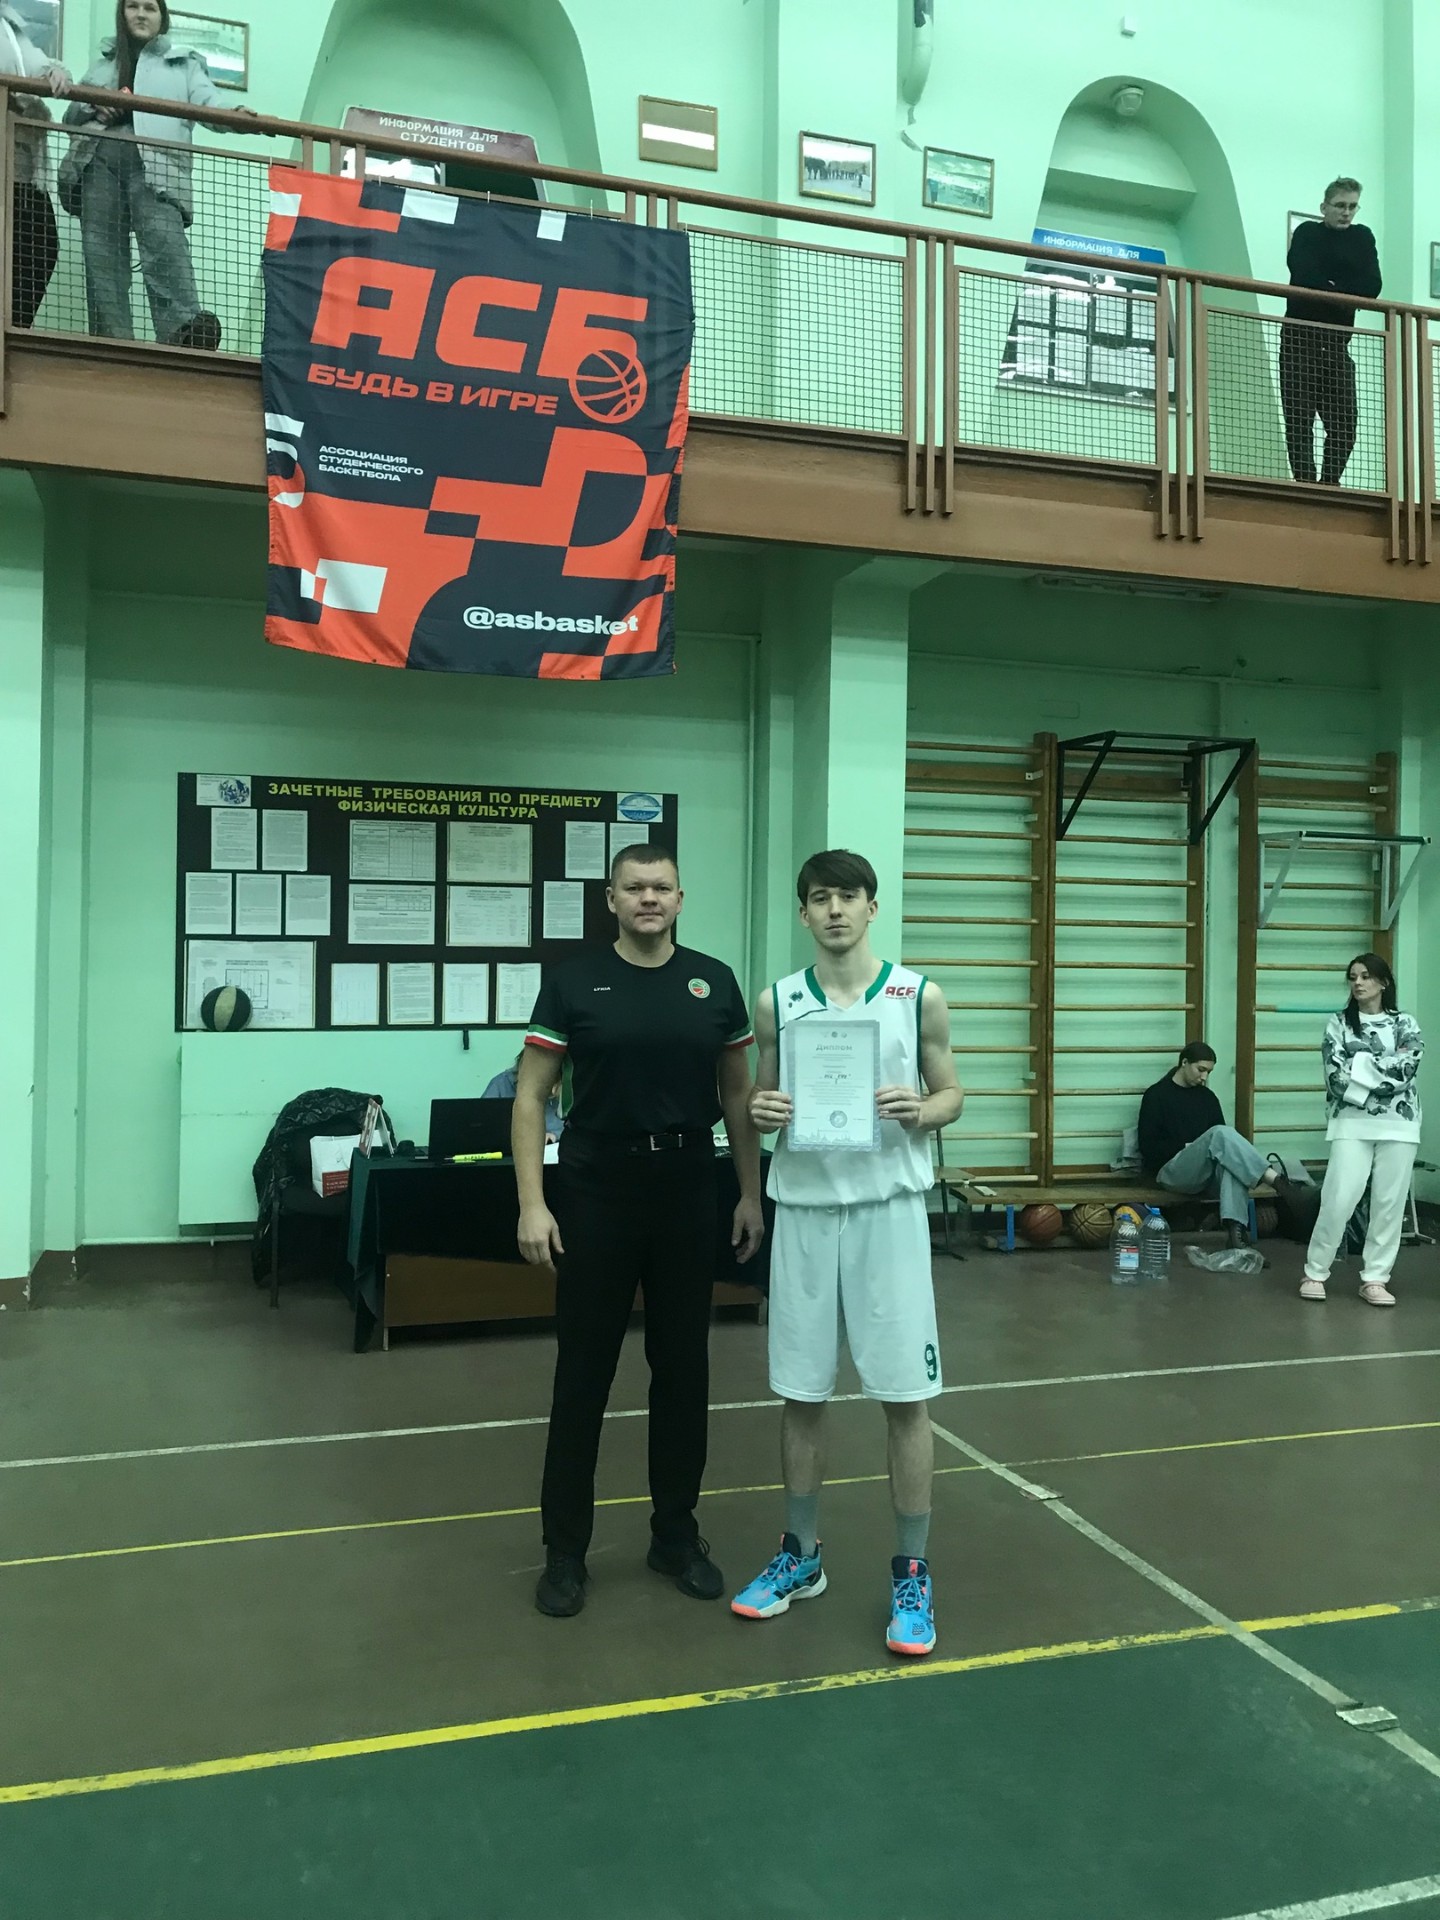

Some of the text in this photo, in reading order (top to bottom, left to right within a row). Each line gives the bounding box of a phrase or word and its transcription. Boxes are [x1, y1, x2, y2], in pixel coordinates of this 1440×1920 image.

[379, 116, 499, 144] ИНФОРМАЦИЯ ДЛЯ
[400, 132, 485, 153] СТУДЕНТОВ
[1043, 235, 1140, 260] ИНФОРМАЦИЯ ДЛЯ
[310, 256, 649, 424] АСБ
[307, 362, 559, 416] БУДЬ В ИГРЕ
[318, 454, 424, 476] СТУДЕНЧЕСКОГО
[319, 445, 408, 464] АССОЦИАЦИЯ
[318, 463, 402, 482] БАСКЕТБОЛА
[462, 605, 639, 637] @asbasket
[268, 782, 602, 808] ЗАЧЕТНЫЕ ТРЕБОВАНИЯ ПО ПРЕДМЕТУ
[337, 800, 539, 819] ФИЗИЧЕСКАЯ КУЛЬТУРА
[924, 1342, 938, 1382] 9
